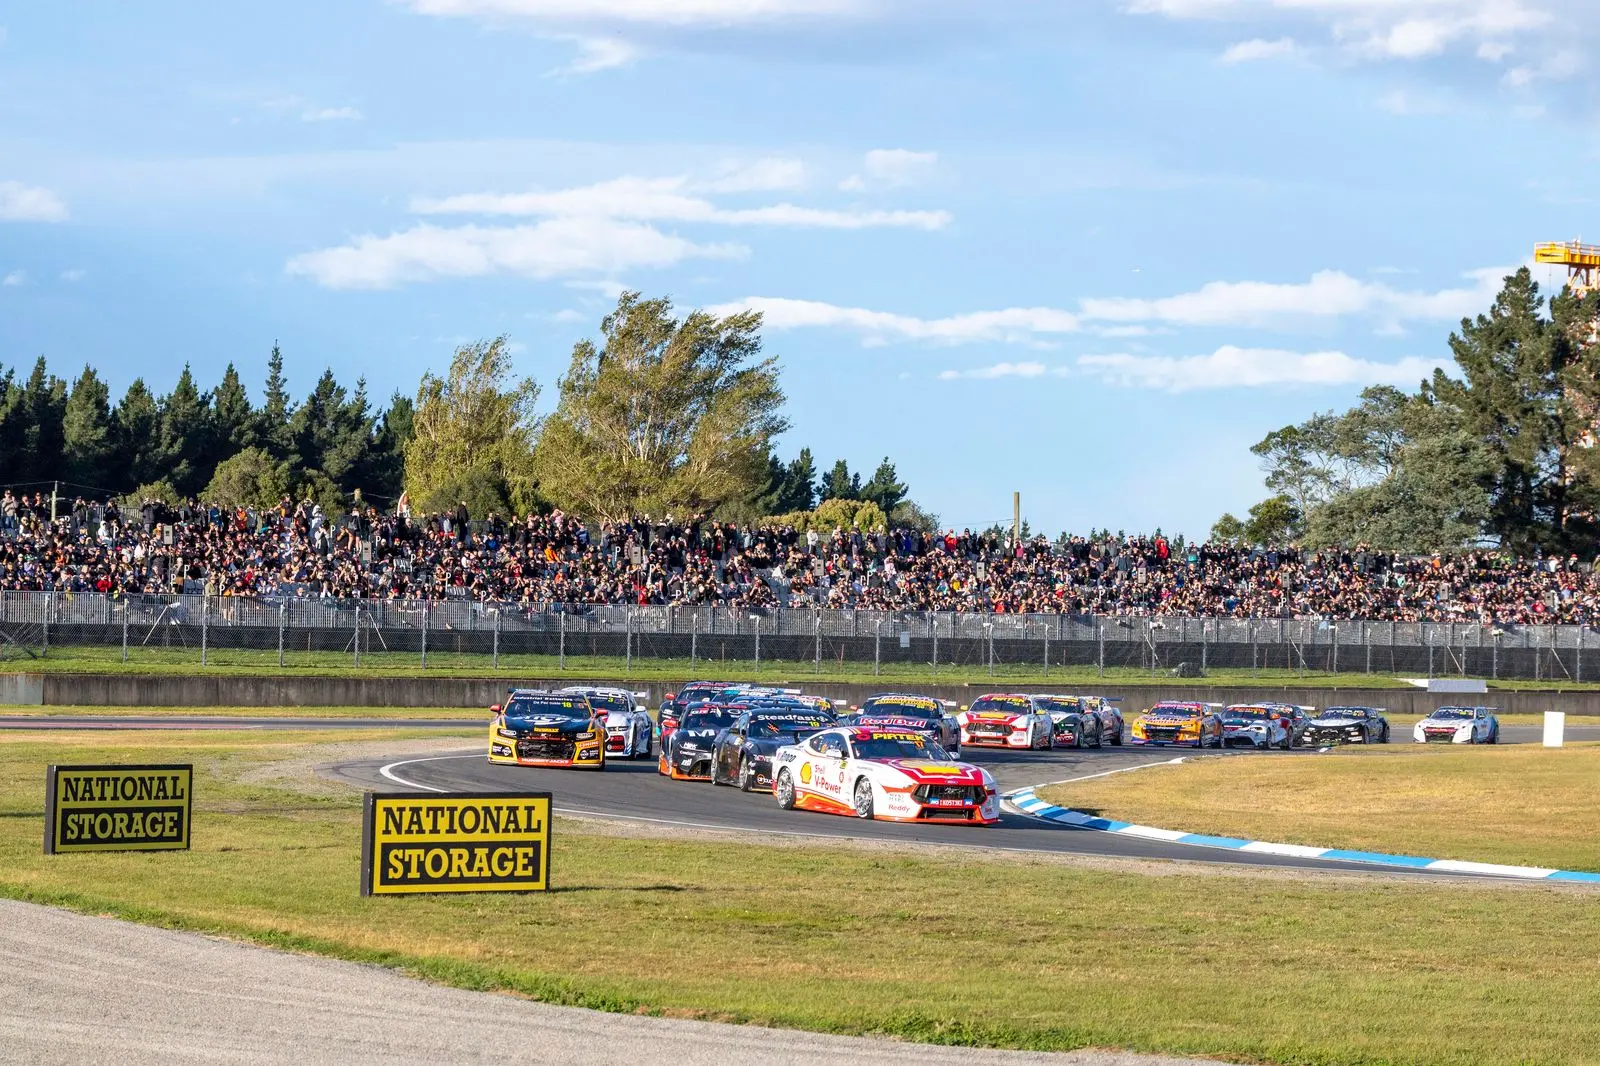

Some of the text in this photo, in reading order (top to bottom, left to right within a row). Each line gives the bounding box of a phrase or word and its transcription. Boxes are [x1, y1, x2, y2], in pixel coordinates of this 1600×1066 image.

[860, 717, 927, 728] Red Bull
[872, 733, 926, 742] PIRTEK
[62, 776, 185, 802] NATIONAL
[814, 775, 842, 795] V-Power
[382, 805, 542, 835] NATIONAL
[888, 804, 911, 813] Reddy
[66, 811, 178, 840] STORAGE
[388, 846, 534, 879] STORAGE
